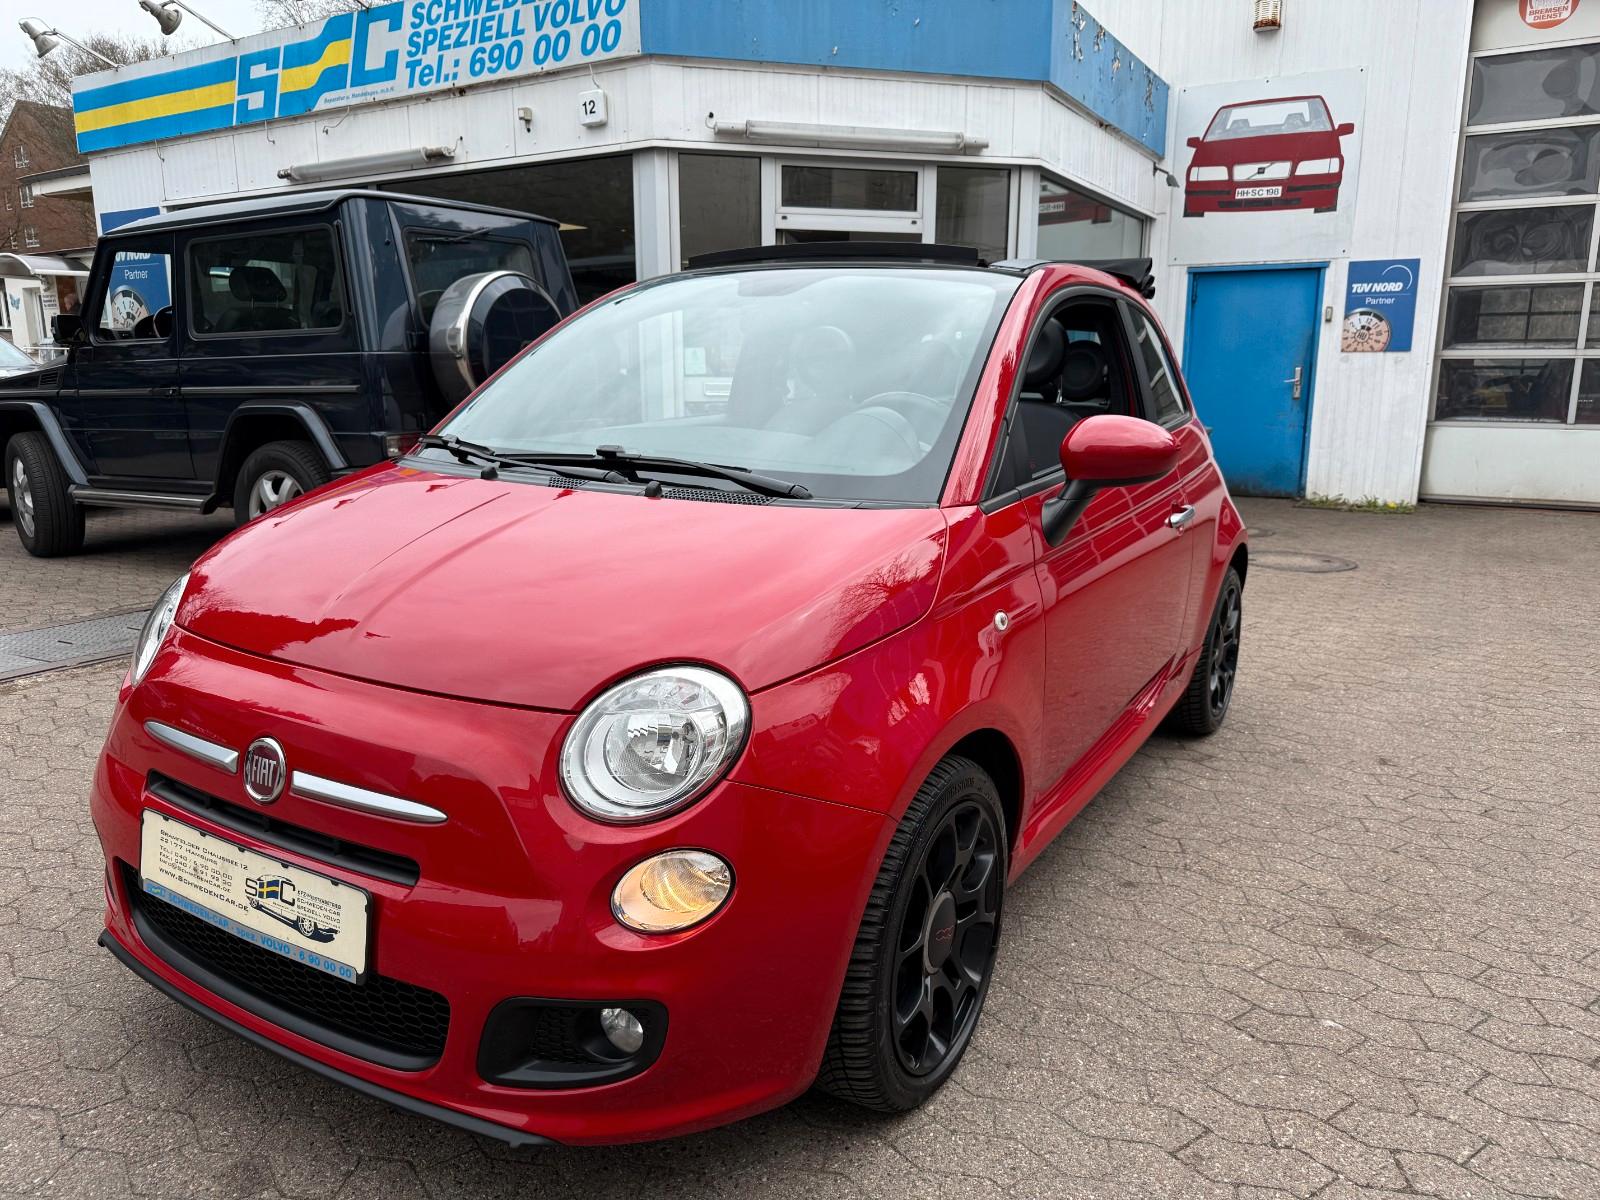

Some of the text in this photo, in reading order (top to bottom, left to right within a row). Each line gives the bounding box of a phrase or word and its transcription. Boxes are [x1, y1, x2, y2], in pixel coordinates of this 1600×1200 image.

[1529, 5, 1568, 16] BREMSEN
[1533, 12, 1563, 21] DIENST
[407, 0, 627, 57] SPEZIELL VOLVO
[405, 18, 622, 89] Tel.: 690 00 00
[582, 100, 596, 115] 12
[124, 269, 148, 280] Partner
[1351, 282, 1404, 293] TÜV NORD
[1365, 297, 1396, 305] Partner
[251, 755, 277, 787] FIAT
[260, 934, 290, 956] VOLVO
[308, 954, 320, 967] 90
[323, 960, 336, 973] 00
[340, 965, 352, 979] 00
